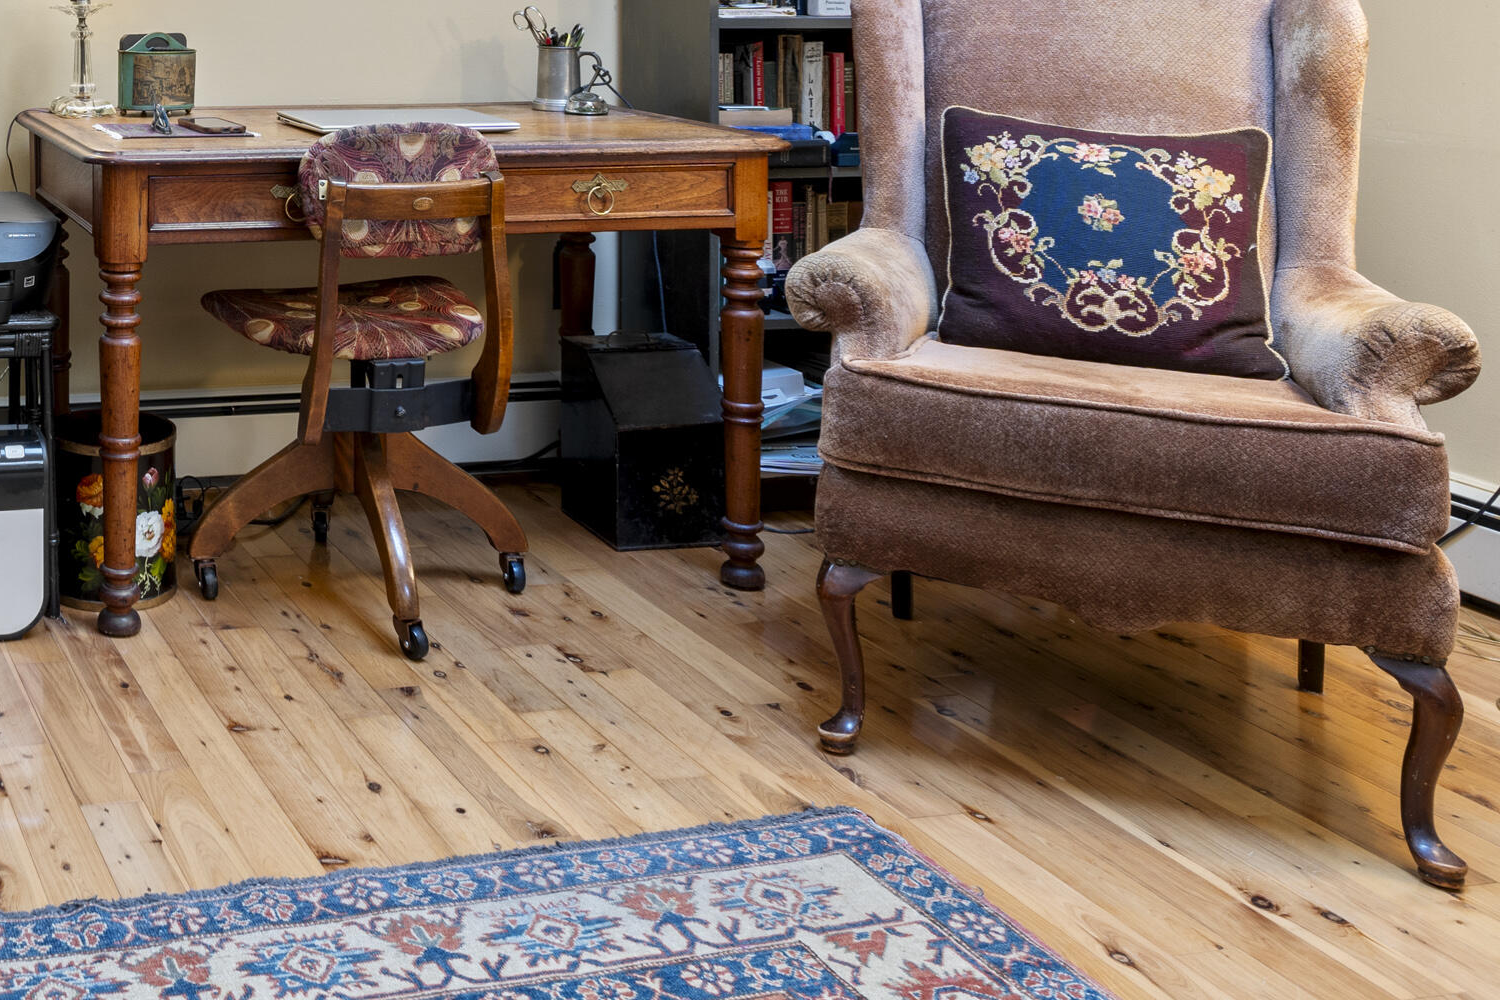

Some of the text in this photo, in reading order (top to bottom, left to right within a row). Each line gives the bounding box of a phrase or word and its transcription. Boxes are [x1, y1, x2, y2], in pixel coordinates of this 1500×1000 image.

[807, 72, 815, 128] LATIN
[774, 188, 789, 196] THE
[774, 196, 789, 204] KID
